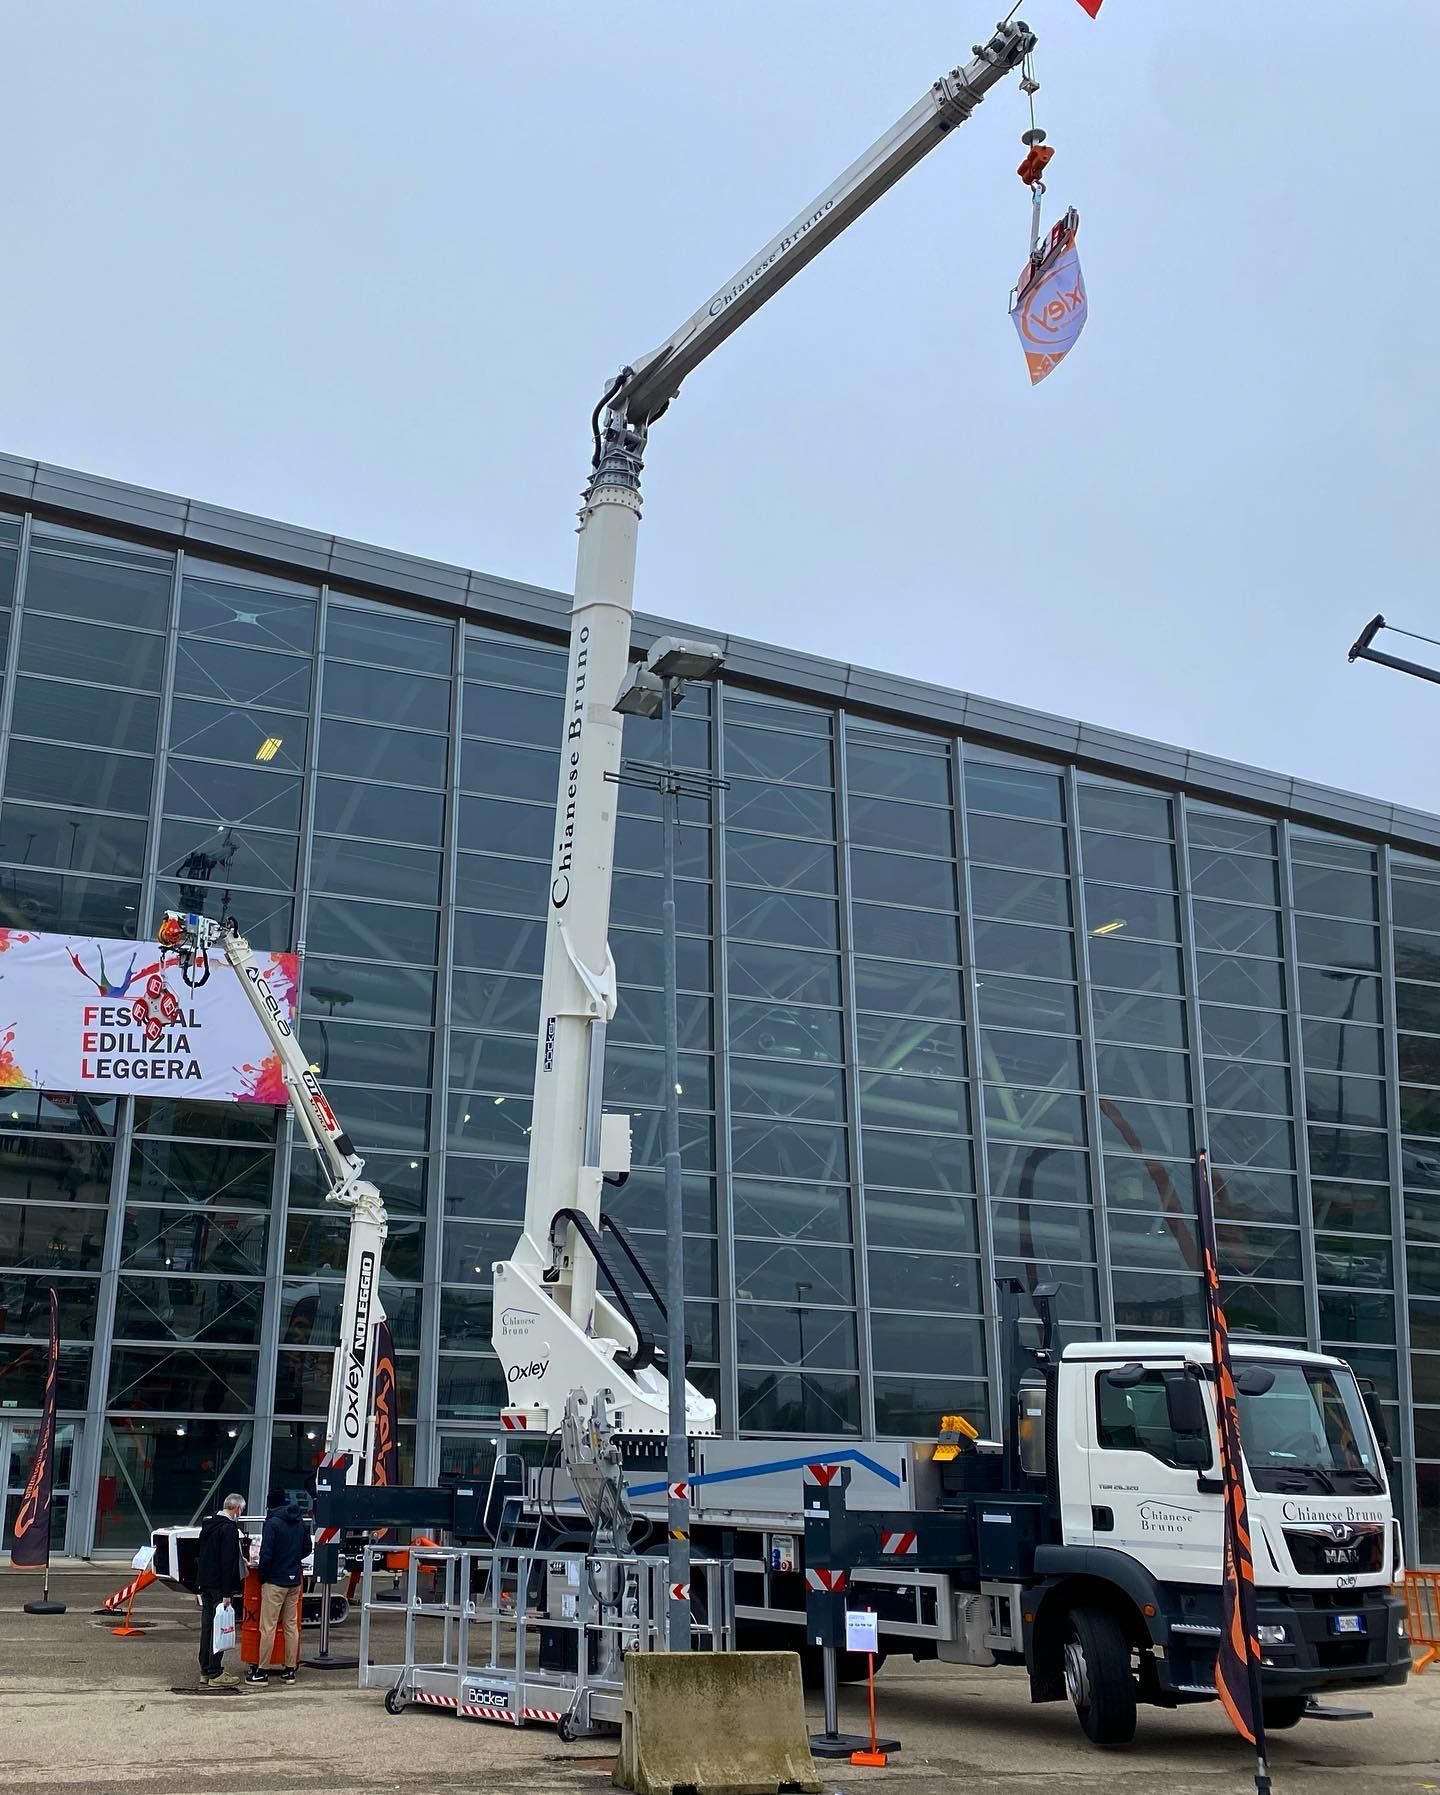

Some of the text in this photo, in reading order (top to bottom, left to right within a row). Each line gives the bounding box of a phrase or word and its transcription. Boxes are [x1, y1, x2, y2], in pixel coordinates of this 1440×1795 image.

[708, 200, 834, 317] Chianese Bruno
[551, 625, 590, 909] Chianese Bruno
[83, 1006, 202, 1028] FESAL
[82, 1032, 192, 1054] EDILIZIA
[81, 1058, 202, 1080] LEGGERA
[502, 1314, 536, 1326] Chianese
[502, 1326, 529, 1336] Bruno
[344, 1257, 373, 1439] Oxley NOLEGGIO
[507, 1359, 550, 1383] Oxley
[1140, 1506, 1193, 1522] Chianese
[1282, 1501, 1383, 1521] Chianese Bruno
[1141, 1520, 1183, 1532] Bruno
[1324, 1549, 1360, 1563] MAN
[1336, 1576, 1358, 1589] Oxley
[468, 1688, 508, 1707] Böcker
